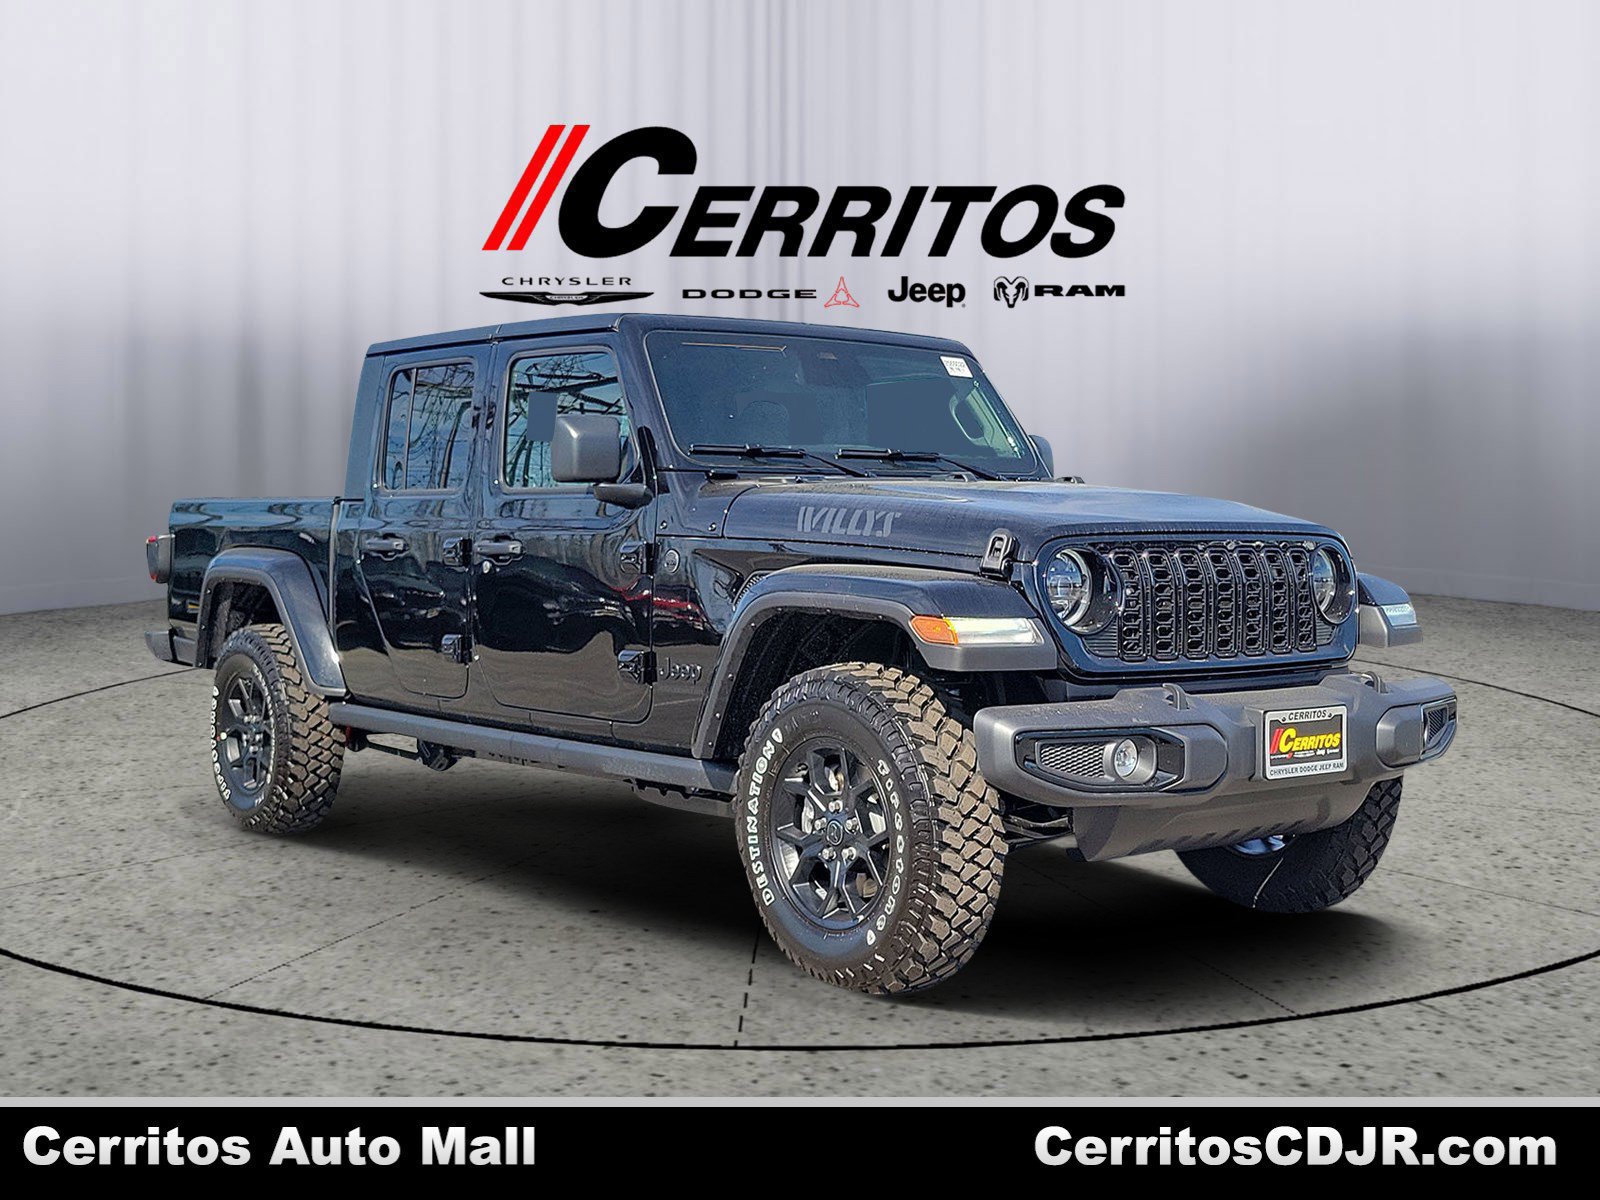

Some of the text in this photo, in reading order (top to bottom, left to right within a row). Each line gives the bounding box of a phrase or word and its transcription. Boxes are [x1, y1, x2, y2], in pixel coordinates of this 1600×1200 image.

[797, 506, 902, 538] WILLYS
[659, 656, 702, 685] Jeep
[1288, 710, 1327, 721] CERRITOS
[1278, 727, 1341, 753] CERRITOS
[1269, 761, 1344, 776] CHRYSLER DODGE JEEP RAM
[747, 740, 783, 906] DESTINATION
